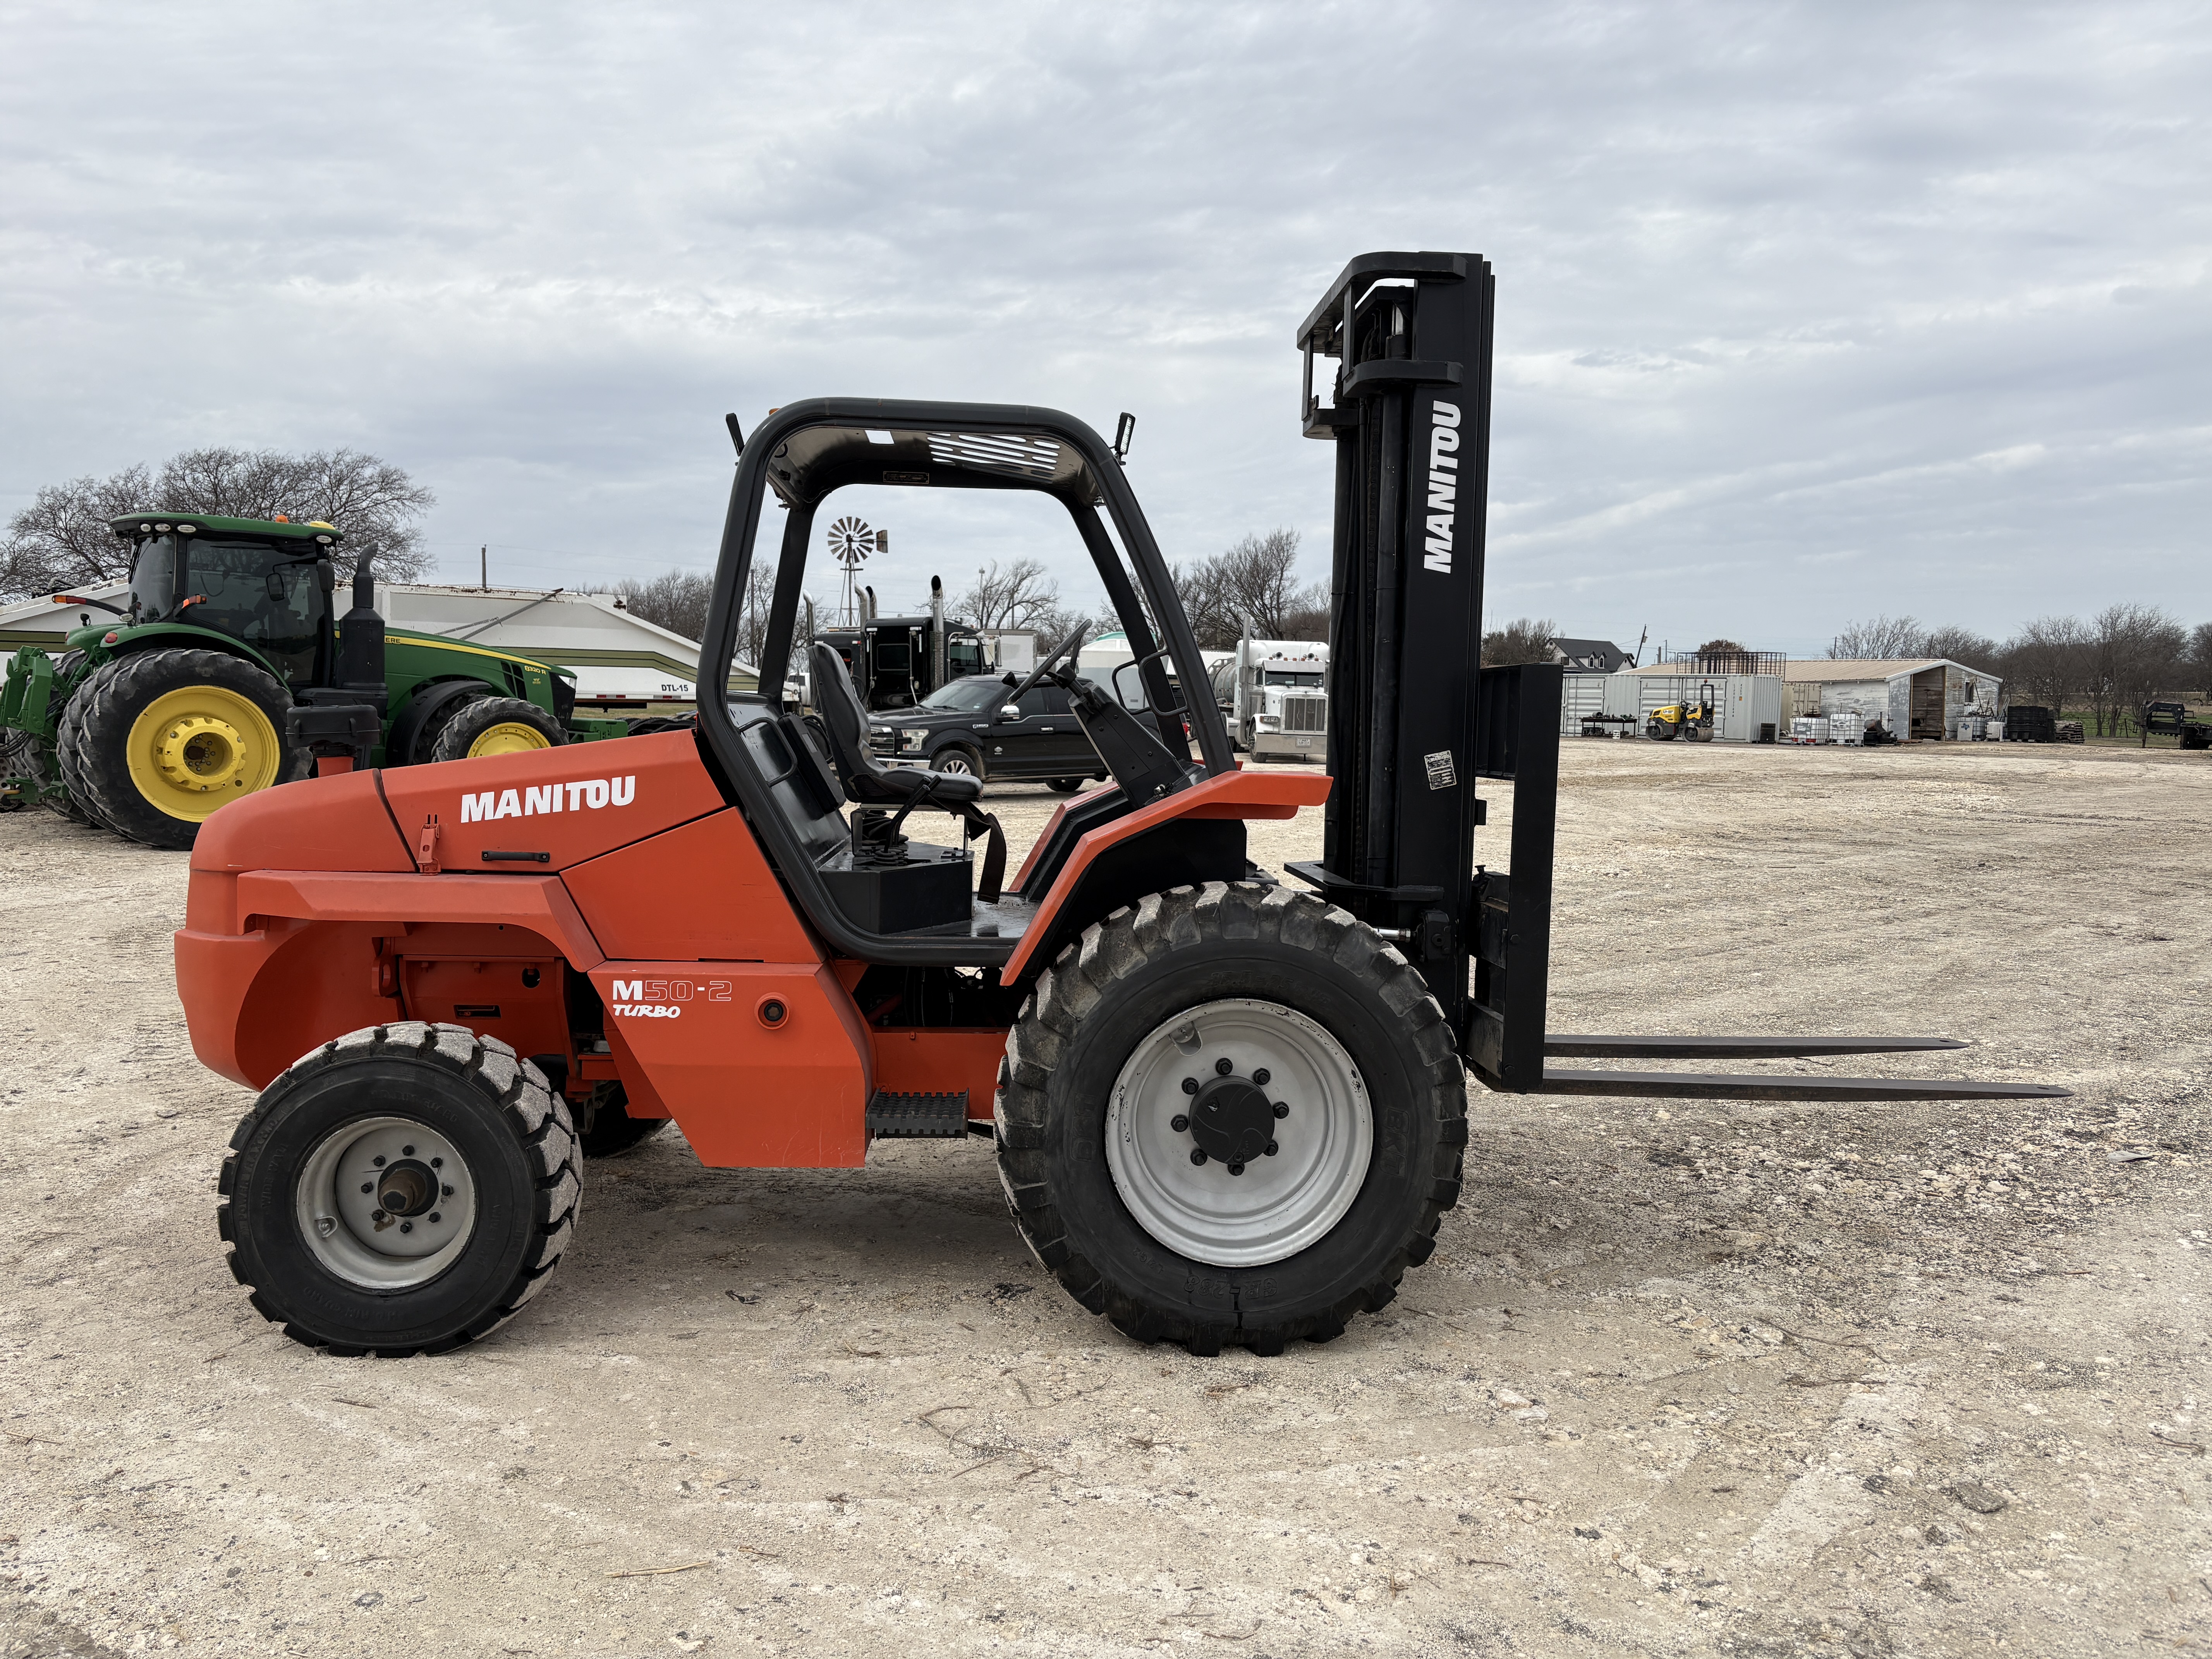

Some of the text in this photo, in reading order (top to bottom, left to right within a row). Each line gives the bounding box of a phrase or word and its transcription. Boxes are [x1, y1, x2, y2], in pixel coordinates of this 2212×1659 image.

[1424, 400, 1461, 574] MANITOU
[460, 775, 635, 823] MANITOU
[613, 980, 732, 1001] M50-2
[613, 1004, 681, 1018] TURBO
[1381, 1106, 1410, 1178] BKT
[1183, 1274, 1278, 1299] GR-288
